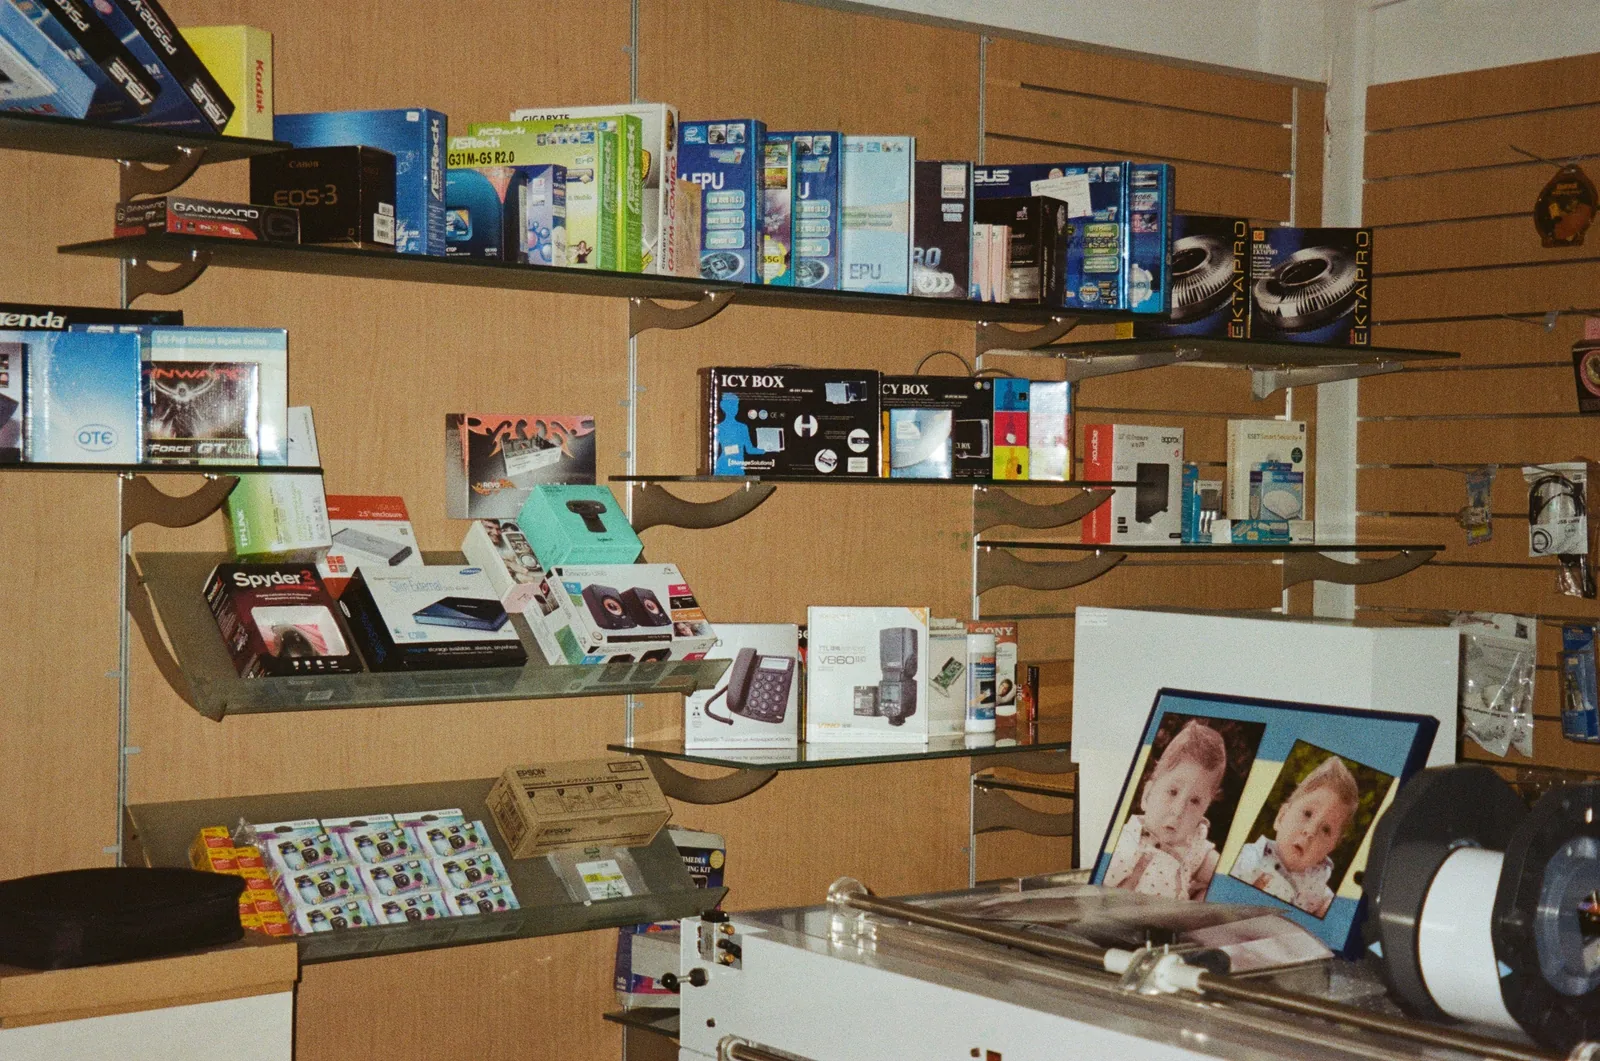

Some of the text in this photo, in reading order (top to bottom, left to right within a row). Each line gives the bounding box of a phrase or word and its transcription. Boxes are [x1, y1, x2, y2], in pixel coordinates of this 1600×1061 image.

[129, 0, 176, 55] P5SD2-V
[109, 60, 153, 105] ASUS
[255, 59, 264, 113] Kodak
[189, 81, 227, 126] ASUS
[521, 113, 571, 122] GIGABYTE
[448, 136, 500, 149] ASRock
[288, 160, 319, 169] Canon
[430, 119, 440, 201] ASRock
[449, 151, 515, 166] G31M-GS R2.0
[691, 172, 725, 190] EPU
[973, 169, 1010, 182] SUS
[274, 184, 338, 206] EOS-3
[174, 202, 259, 219] GAINWARD
[668, 156, 677, 271] G41M-COMBO
[850, 263, 882, 280] EPU
[1231, 220, 1246, 338] EKTAPRO
[1354, 231, 1369, 345] EKTAPRO
[721, 375, 785, 389] ICY BOX
[882, 383, 930, 396] CY BOX
[233, 570, 317, 588] Spyder3
[975, 626, 1014, 636] SONY
[516, 768, 546, 777] EPSON
[700, 866, 711, 874] KIT
